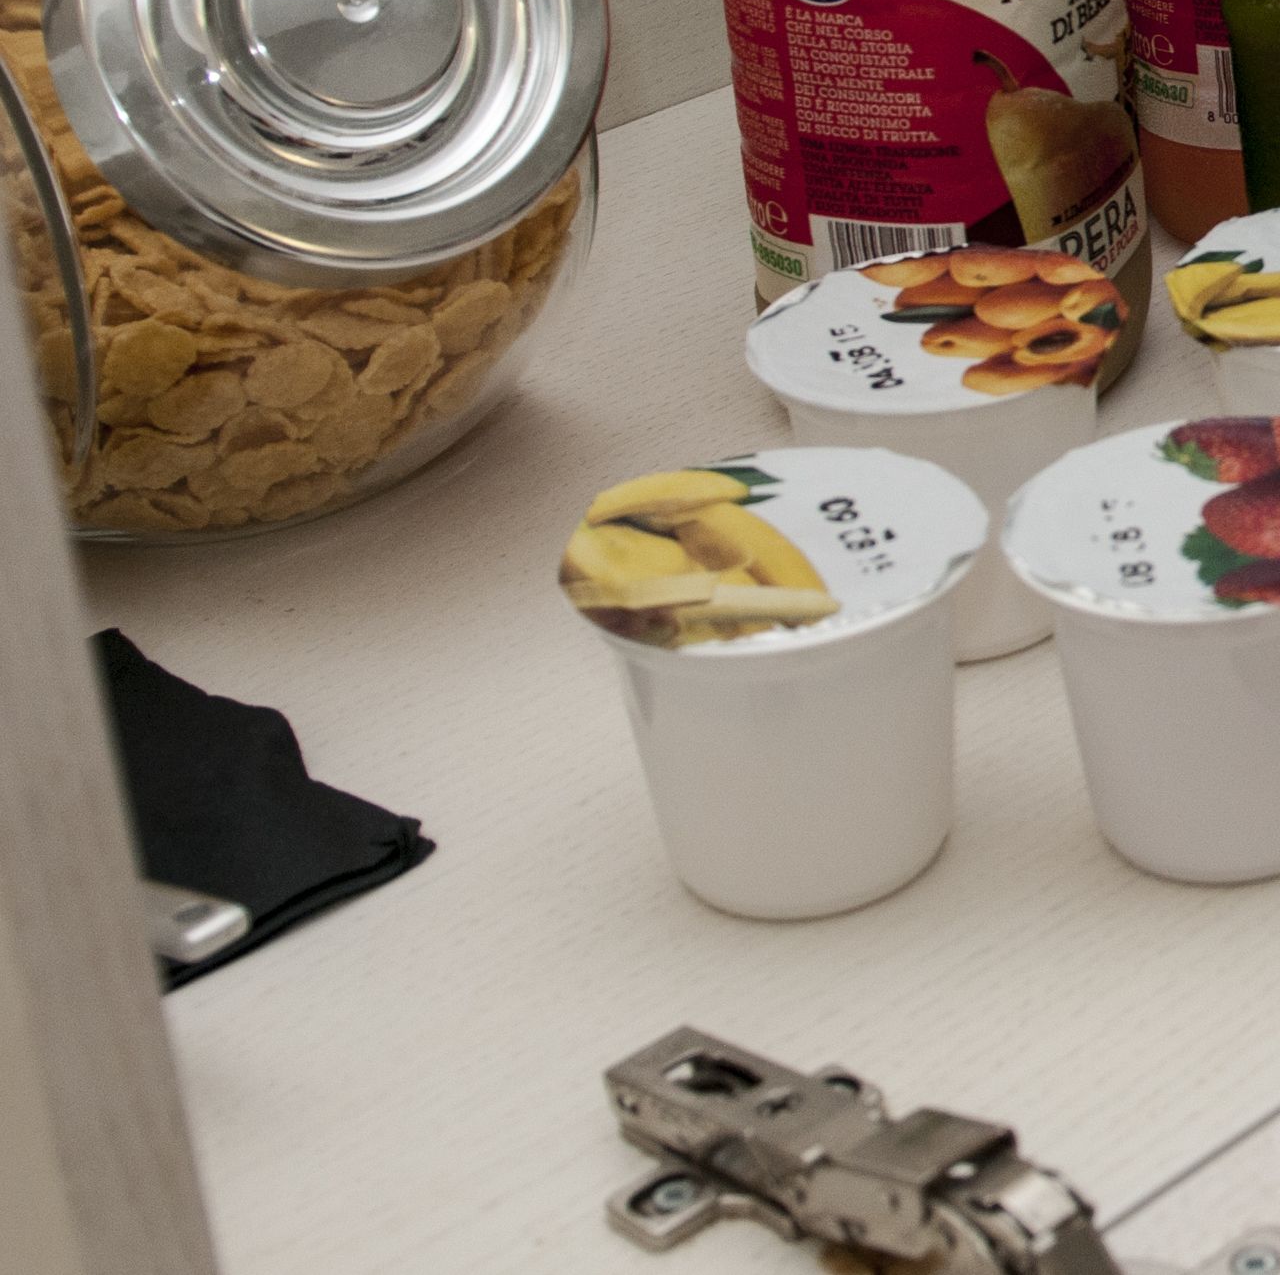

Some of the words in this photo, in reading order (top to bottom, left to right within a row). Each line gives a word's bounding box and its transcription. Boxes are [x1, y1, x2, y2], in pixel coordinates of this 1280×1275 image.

[795, 9, 812, 21] LA
[814, 11, 863, 27] MARCA
[1050, 10, 1077, 45] DI
[785, 20, 813, 34] CHE
[815, 24, 842, 38] NEL
[843, 28, 893, 42] CORSO
[787, 33, 829, 50] DELLA
[830, 38, 858, 52] SUA
[860, 41, 914, 55] STORIA
[789, 46, 808, 59] HA
[810, 49, 909, 68] CONQUISTATO
[790, 58, 810, 71] UN
[812, 62, 857, 77] POSTO
[859, 67, 936, 80] CENTRALE
[792, 71, 833, 87] NELLA
[835, 76, 886, 91] MENTE
[794, 83, 816, 96] DEI
[818, 86, 921, 104] CONSUMATORI
[795, 95, 812, 109] ED
[826, 99, 933, 118] RICONOSCIUTA
[1207, 111, 1216, 123] 8
[795, 108, 834, 124] COME
[836, 112, 911, 130] SINONIMO
[797, 121, 812, 133] DI
[814, 124, 860, 140] SUCCO
[862, 128, 879, 141] DI
[819, 496, 859, 523] 09
